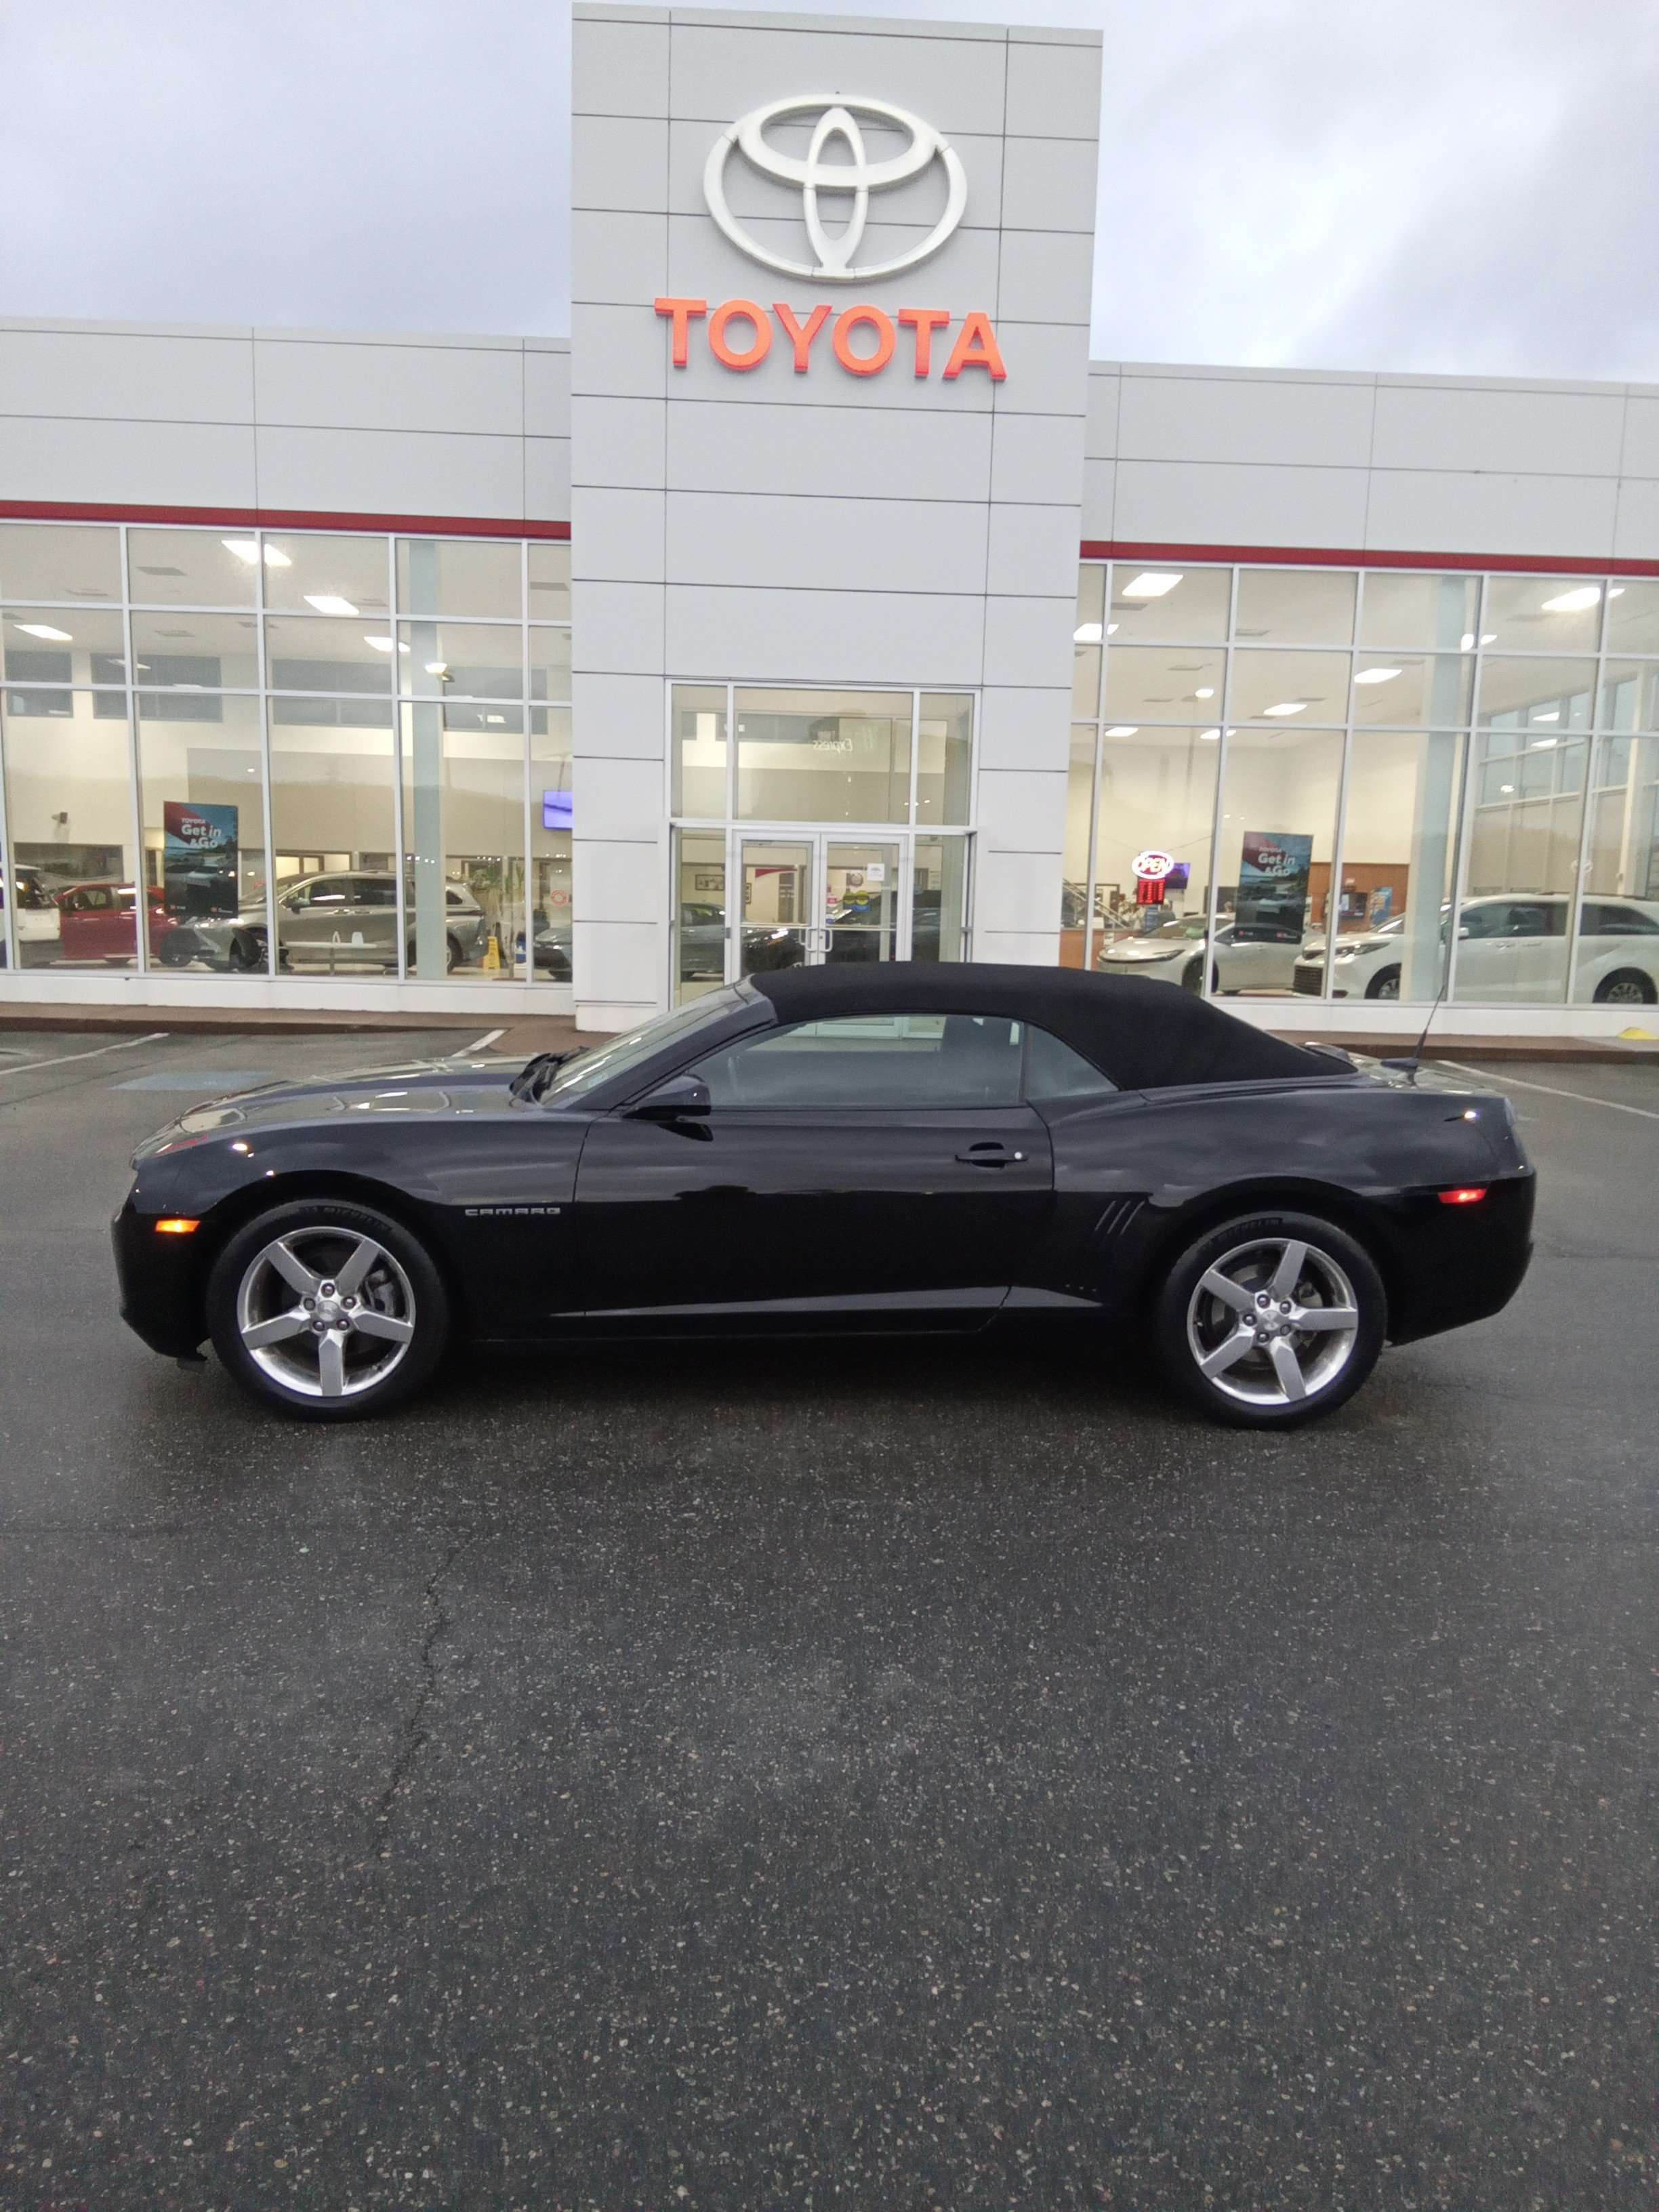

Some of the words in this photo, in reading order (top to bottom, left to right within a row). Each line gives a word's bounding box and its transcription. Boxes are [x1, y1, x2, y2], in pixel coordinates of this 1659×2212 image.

[655, 298, 1007, 380] TOYOTA
[181, 824, 207, 836] Get
[209, 825, 222, 837] in
[1135, 857, 1170, 873] OPEN
[1258, 853, 1282, 864] Get
[1283, 853, 1295, 865] in
[465, 1207, 560, 1216] CAMARO
